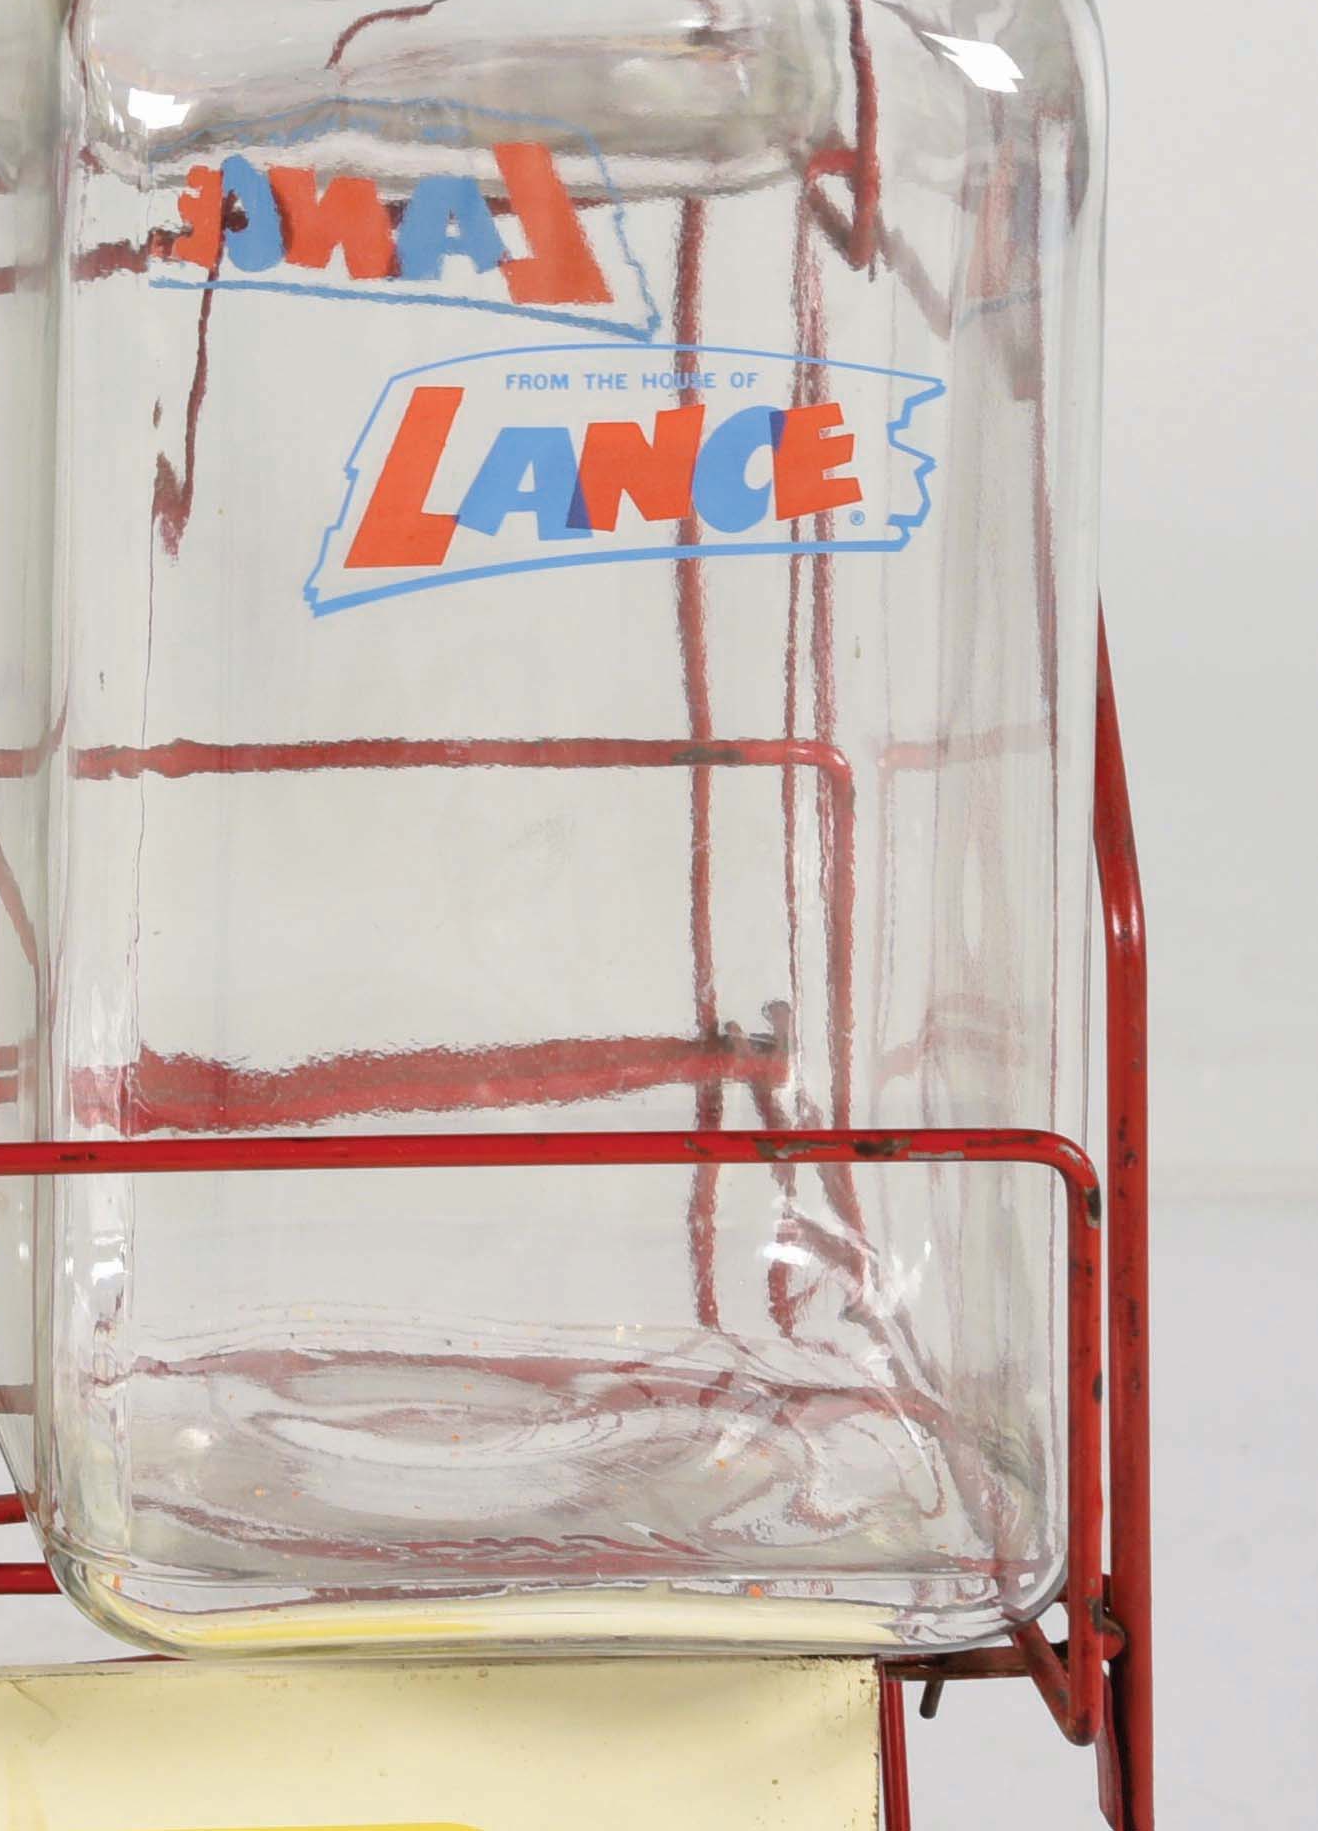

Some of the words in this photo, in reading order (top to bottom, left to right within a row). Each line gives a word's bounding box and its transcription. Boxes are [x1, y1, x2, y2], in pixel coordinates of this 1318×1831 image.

[505, 372, 570, 391] FROM
[584, 372, 628, 391] THE
[641, 371, 717, 390] HOUSE
[730, 371, 759, 390] OF
[344, 386, 864, 568] LANCE
